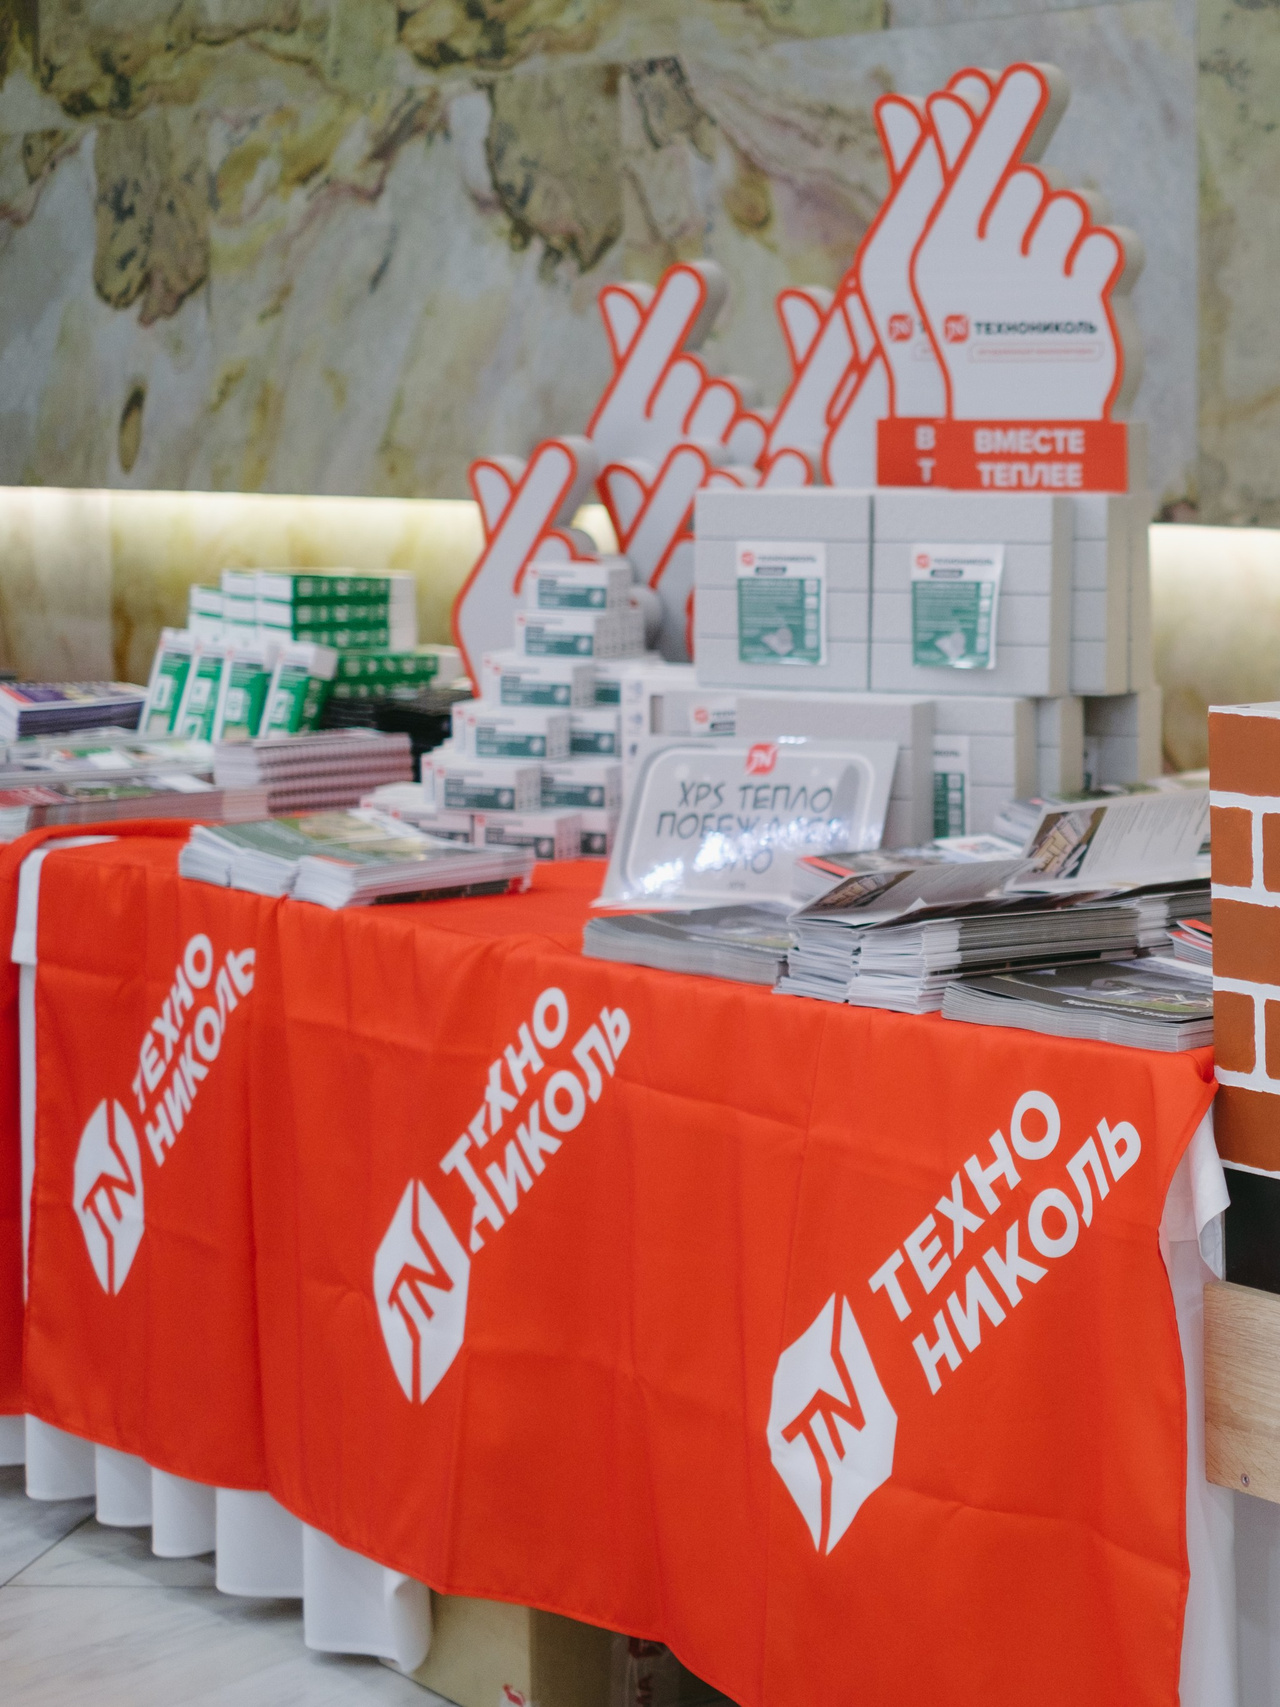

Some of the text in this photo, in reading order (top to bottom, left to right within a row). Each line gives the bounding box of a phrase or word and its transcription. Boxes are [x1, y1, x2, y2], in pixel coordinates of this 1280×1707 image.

[974, 428, 1085, 454] ВМЕСТЕ
[977, 462, 1083, 487] ТЕПЛЕЕ
[739, 784, 833, 814] ТЕПЛО
[132, 933, 213, 1114] ТЕХНО
[145, 947, 256, 1168] НИКОЛЬ
[868, 1090, 1061, 1322] ТЕХНО
[912, 1117, 1141, 1396] НИКОЛЬ
